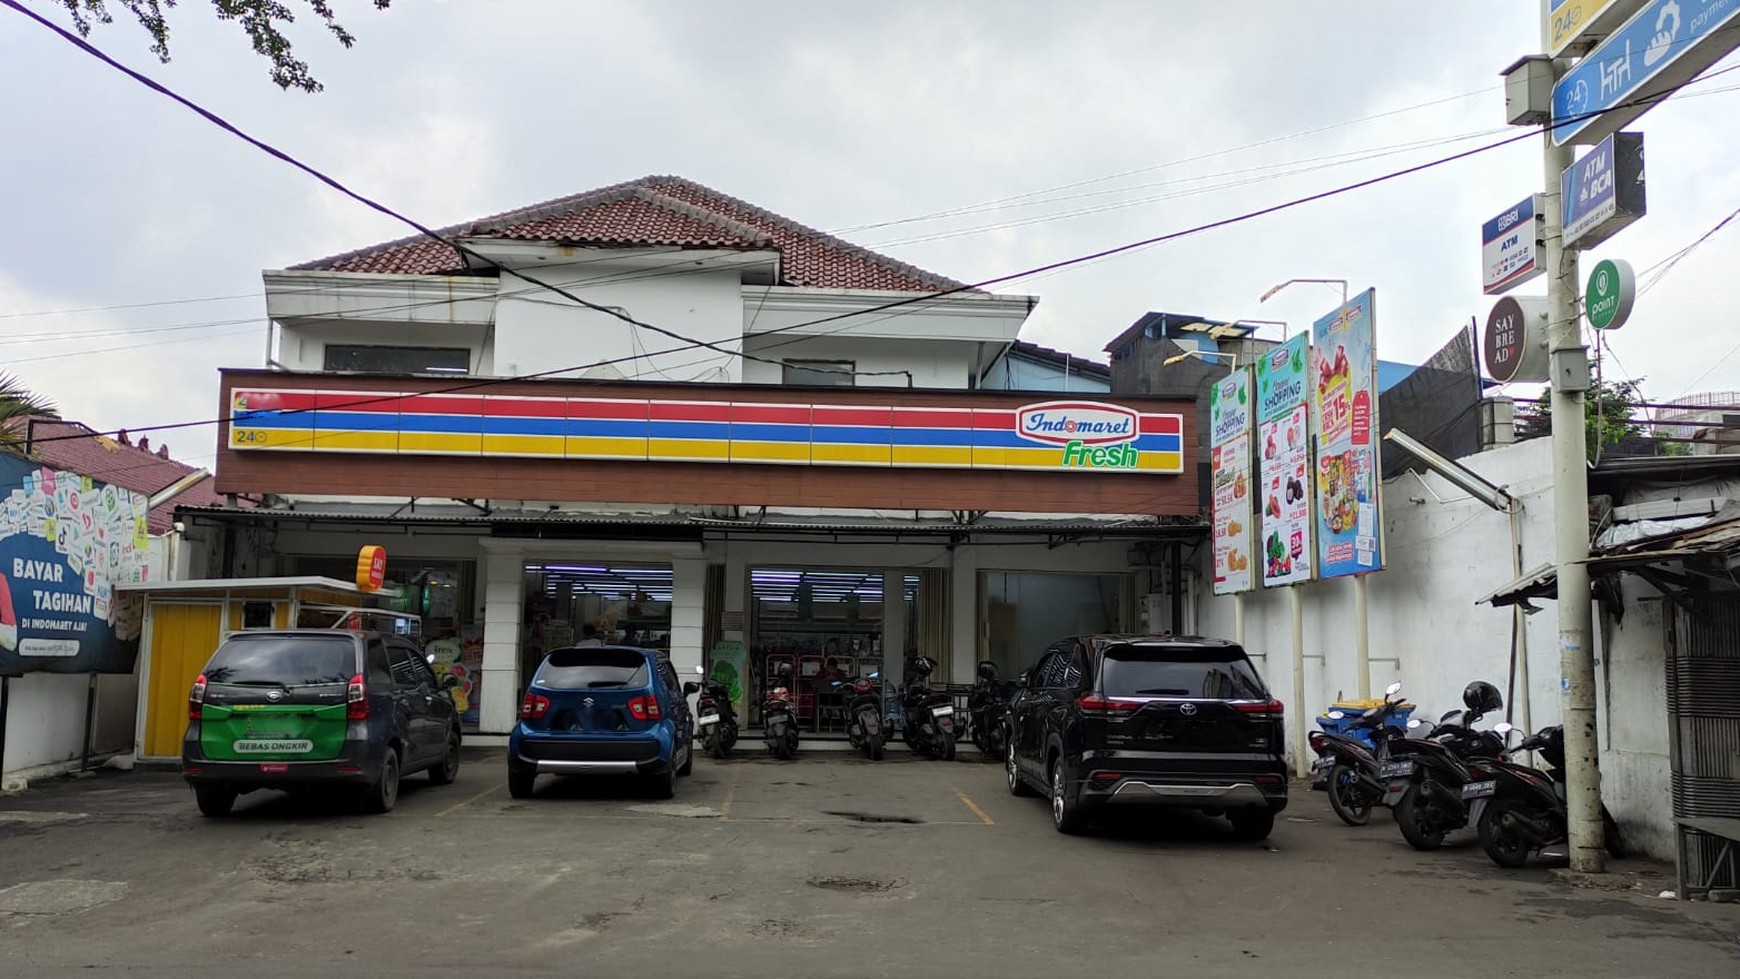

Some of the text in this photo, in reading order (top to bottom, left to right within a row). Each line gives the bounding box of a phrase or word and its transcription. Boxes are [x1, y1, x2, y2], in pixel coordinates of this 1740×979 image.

[1583, 150, 1606, 183] ATM
[1590, 169, 1612, 199] BCA
[1507, 209, 1519, 225] BRI
[1501, 235, 1518, 252] ATM
[1495, 314, 1515, 333] SAY
[1496, 330, 1515, 349] BRE
[1495, 348, 1509, 364] AD
[1264, 381, 1301, 411] SHOPPING
[1026, 412, 1129, 434] Indomaret
[1216, 412, 1245, 437] SHOPPING
[237, 431, 254, 443] 24
[13, 557, 63, 582] BAYAR
[33, 590, 91, 613] TAGIHAN
[21, 618, 87, 632] DI INDOMARET AJA!
[238, 742, 308, 750] BEBAS ONGKIR
